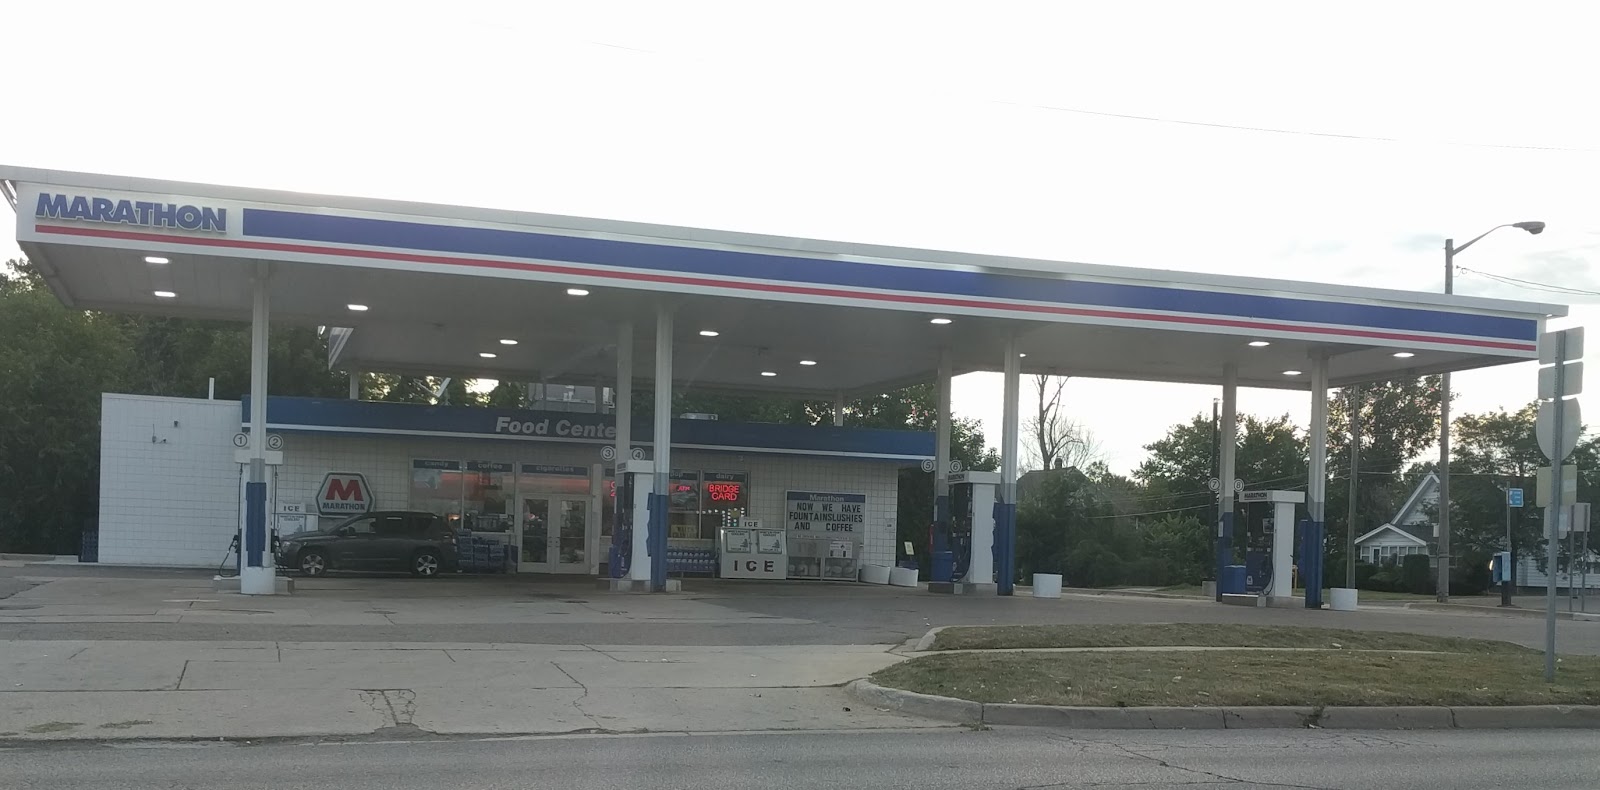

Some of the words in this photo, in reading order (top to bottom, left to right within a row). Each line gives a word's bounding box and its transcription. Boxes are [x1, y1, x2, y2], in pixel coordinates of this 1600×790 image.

[35, 192, 227, 233] MARATHON
[495, 416, 550, 435] Food
[556, 419, 617, 438] Cente
[425, 461, 449, 469] candy
[478, 462, 503, 470] coffee
[536, 465, 575, 473] cigarettes
[715, 472, 735, 480] dairy
[325, 479, 364, 501] M
[709, 484, 740, 493] BRIDGE
[712, 492, 737, 501] CARD
[809, 494, 845, 502] Marathon
[322, 502, 366, 511] MARATHON
[796, 502, 814, 511] NOW
[821, 503, 833, 512] WE
[841, 504, 861, 513] HAVE
[794, 521, 811, 531] AND
[825, 523, 853, 532] COFFEE
[733, 560, 774, 572] ICE
